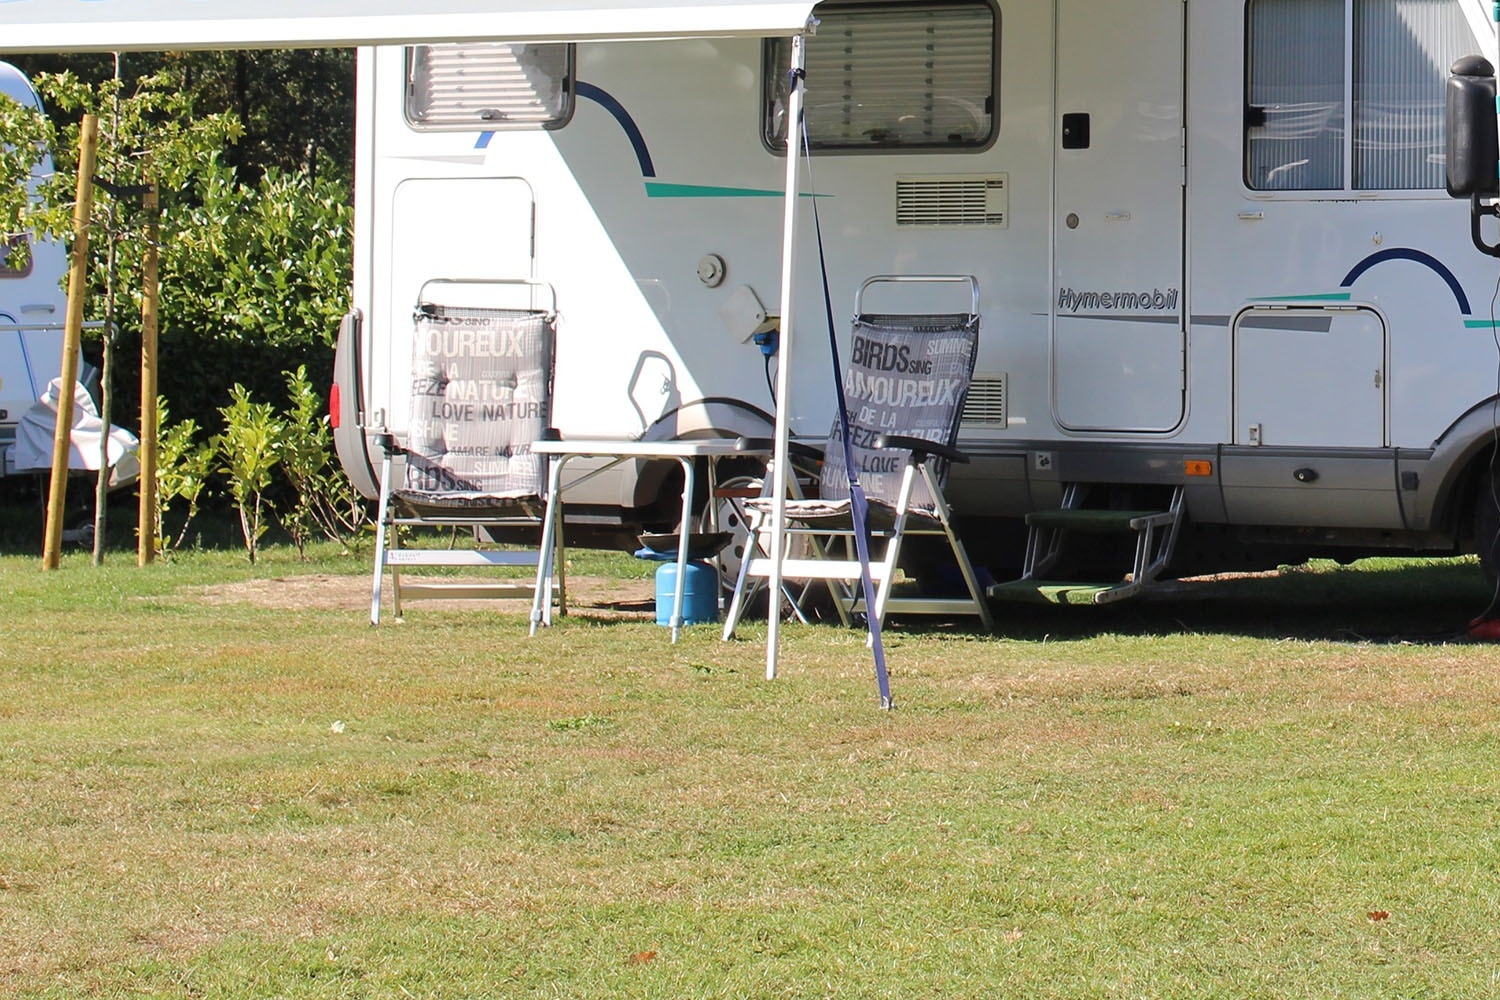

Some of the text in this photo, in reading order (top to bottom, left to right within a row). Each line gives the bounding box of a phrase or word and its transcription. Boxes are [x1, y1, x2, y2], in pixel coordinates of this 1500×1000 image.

[1058, 287, 1178, 312] Hymermobil
[851, 335, 910, 374] BIRDS
[908, 360, 933, 376] SING
[450, 379, 530, 401] NATUE
[844, 368, 960, 408] AMOUREUX
[431, 401, 547, 421] LOVE NATURE
[859, 405, 877, 426] DE
[880, 411, 897, 429] LA
[862, 455, 899, 474] LOVE
[456, 479, 483, 491] SING
